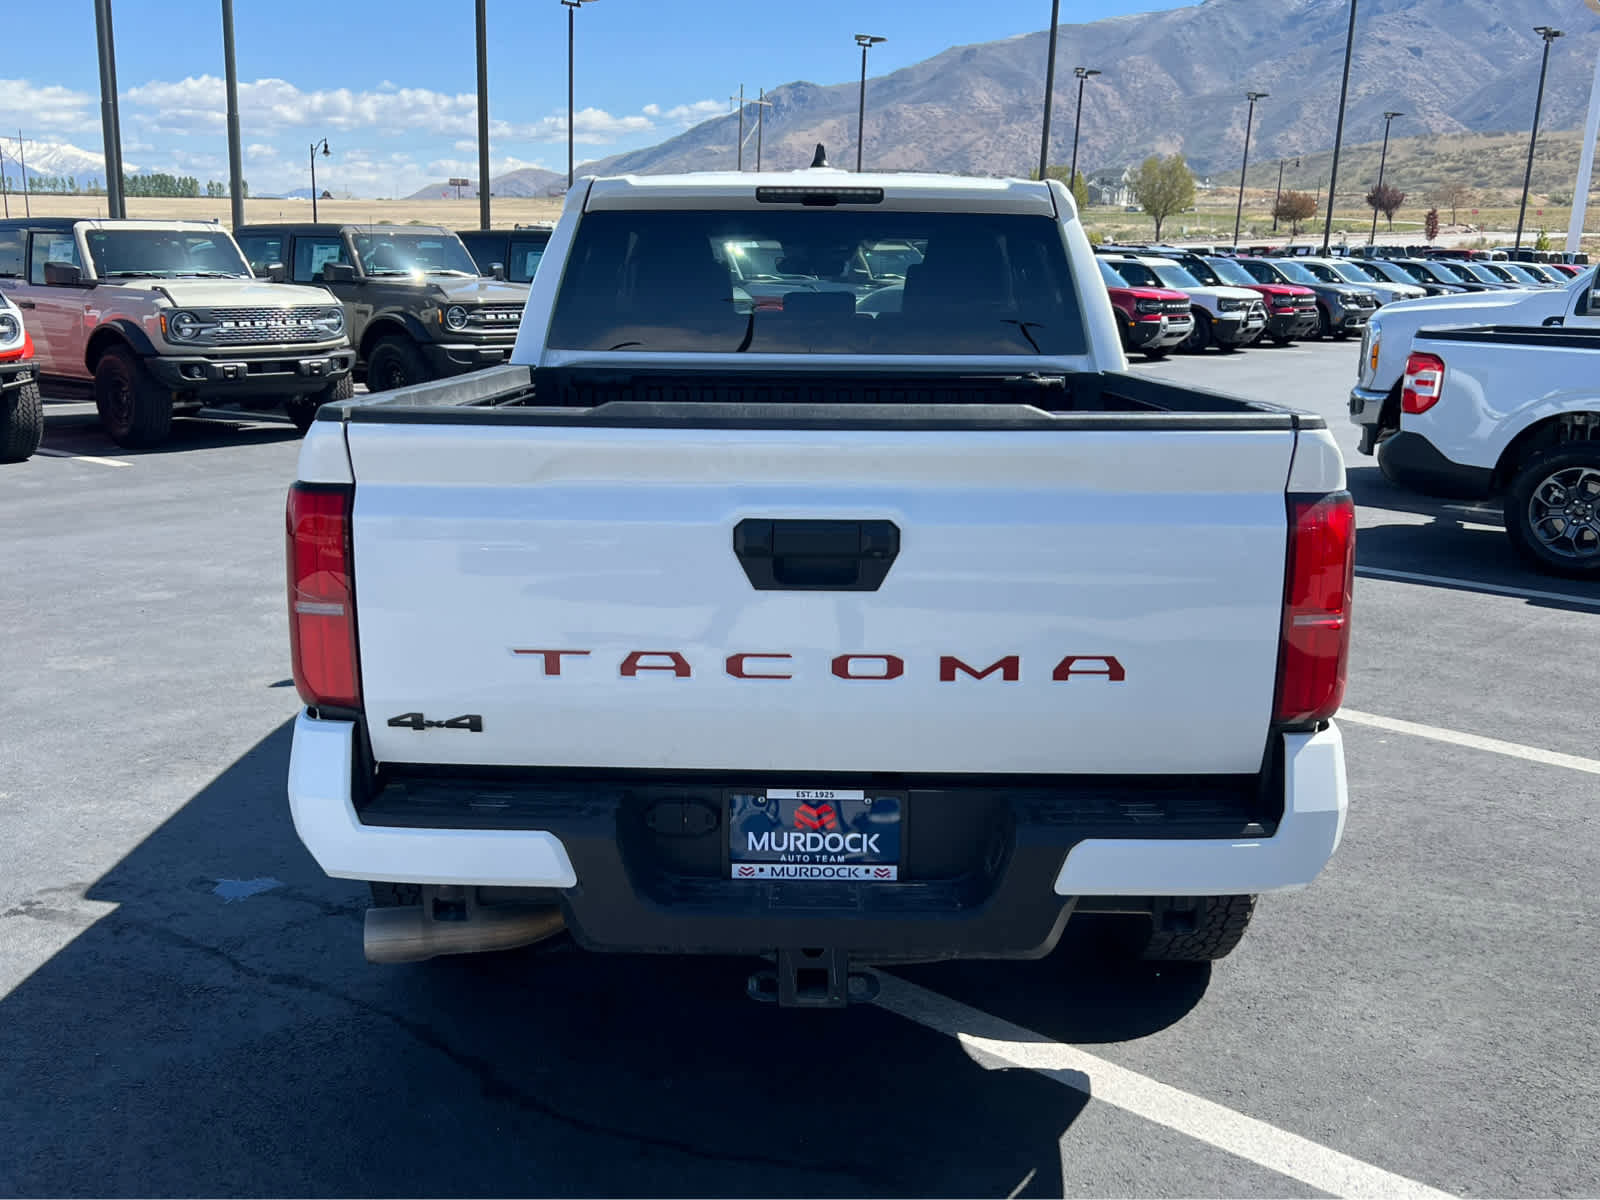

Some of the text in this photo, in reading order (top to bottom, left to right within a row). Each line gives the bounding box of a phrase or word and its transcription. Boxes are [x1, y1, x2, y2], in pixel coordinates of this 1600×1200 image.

[221, 319, 312, 328] BRONCO
[513, 648, 1126, 682] TACOMA
[796, 790, 834, 799] EST. 1925
[747, 831, 880, 853] MURDOCK
[780, 854, 845, 863] AUTO TEAM
[770, 866, 860, 878] MURDOCK
